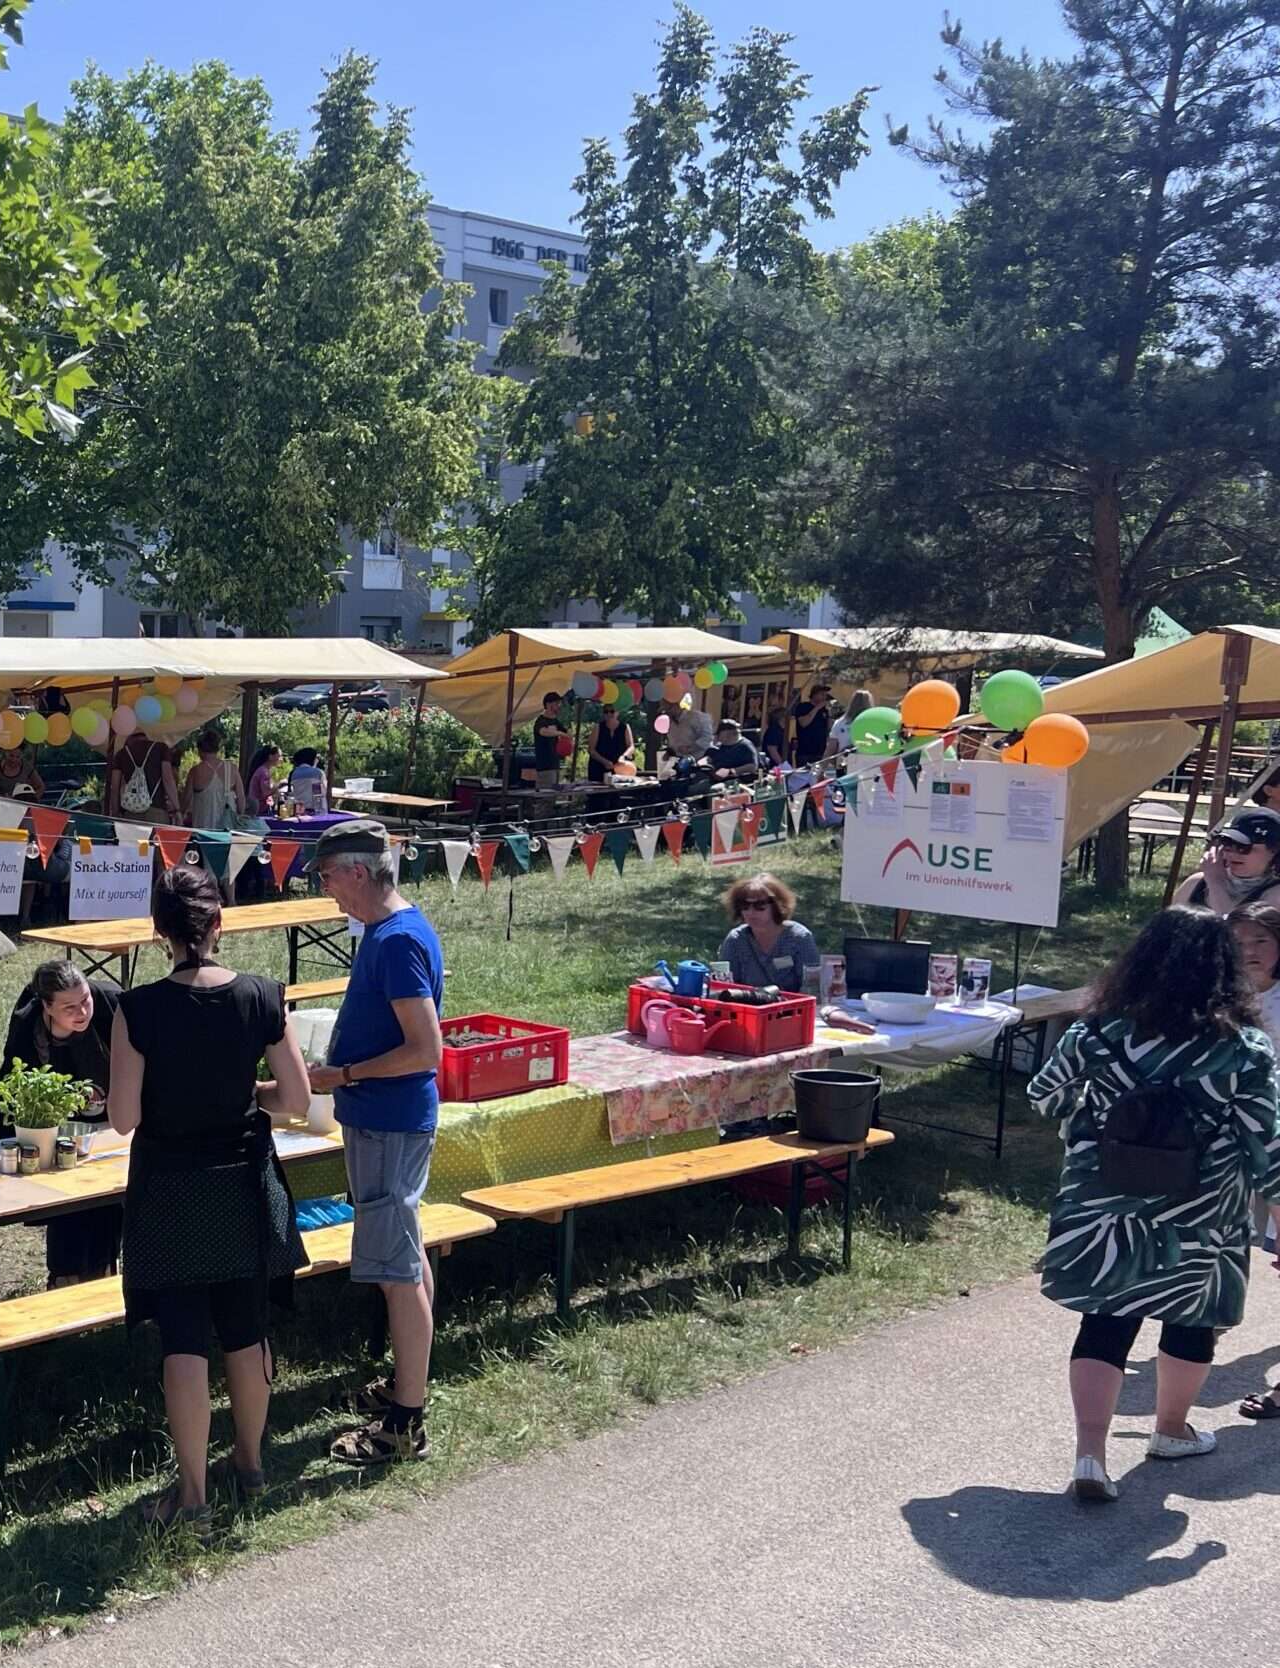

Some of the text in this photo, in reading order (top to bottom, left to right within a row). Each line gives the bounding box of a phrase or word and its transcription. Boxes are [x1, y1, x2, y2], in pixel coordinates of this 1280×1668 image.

[491, 236, 524, 260] 1966
[74, 860, 151, 873] Snack-Station
[928, 842, 993, 872] USE
[923, 873, 1013, 892] Unionhilfswerk
[74, 887, 95, 899] Mix
[97, 887, 106, 899] it
